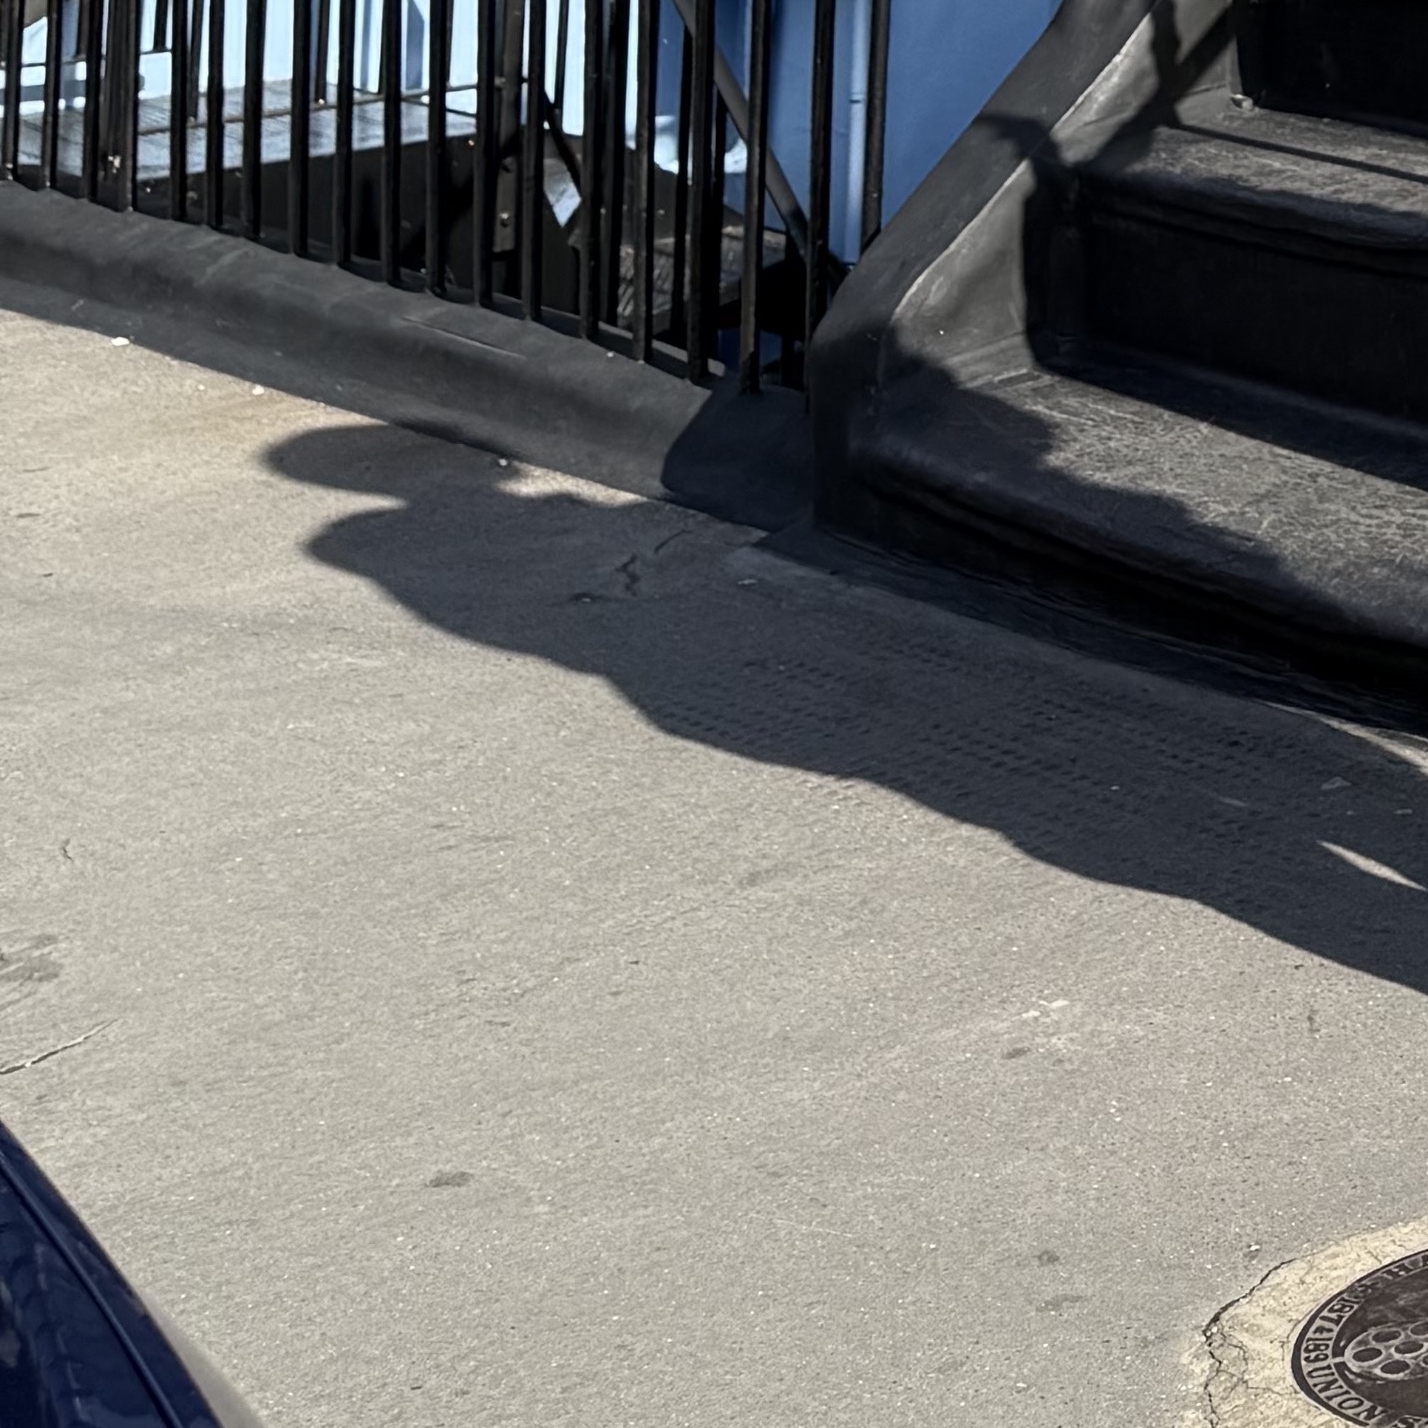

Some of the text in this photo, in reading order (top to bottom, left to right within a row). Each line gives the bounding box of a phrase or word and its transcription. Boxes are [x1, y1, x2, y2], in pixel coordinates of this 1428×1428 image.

[1317, 1295, 1365, 1327] 187
[1302, 1337, 1334, 1364] 189
[1304, 1363, 1388, 1422] UNION
